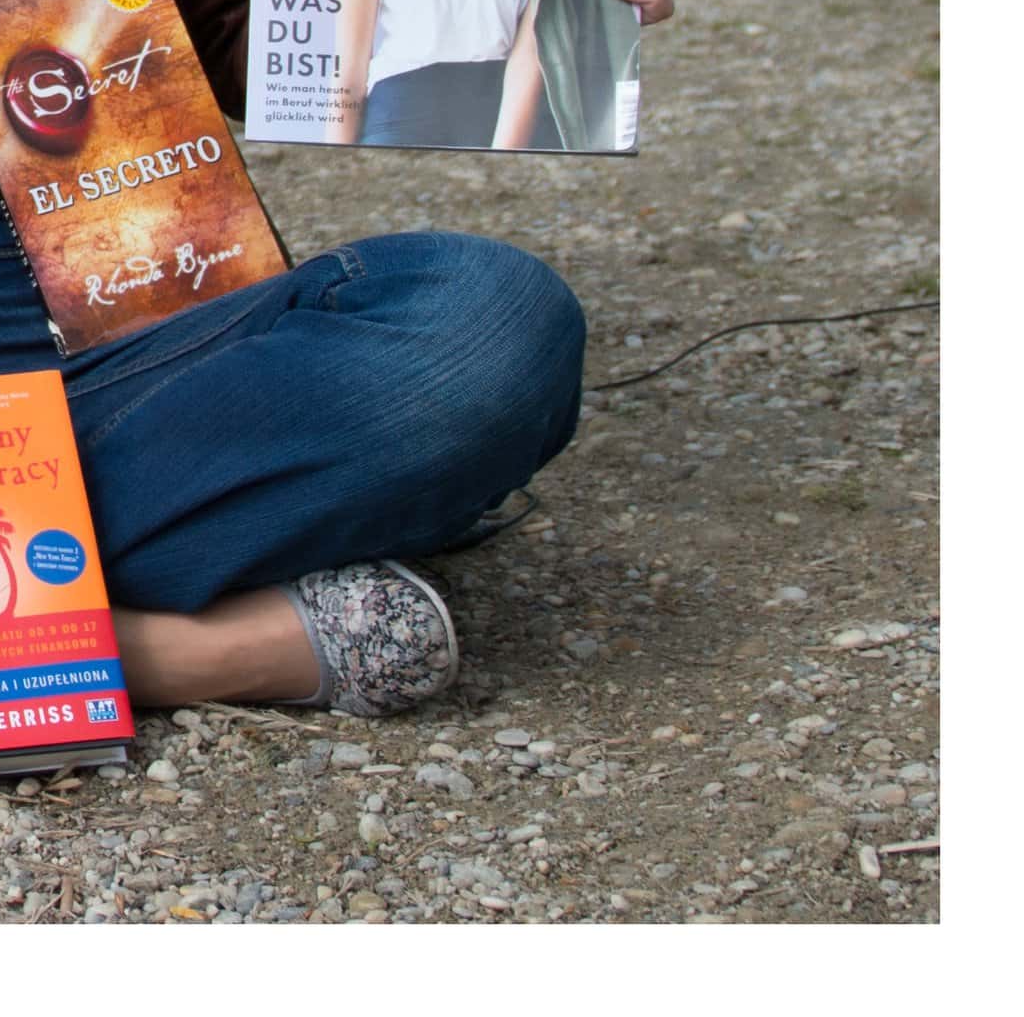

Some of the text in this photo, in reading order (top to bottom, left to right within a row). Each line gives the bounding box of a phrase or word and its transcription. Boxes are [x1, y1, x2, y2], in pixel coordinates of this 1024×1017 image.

[268, 20, 312, 44] DU
[266, 52, 340, 78] BIST!
[29, 39, 172, 117] Secret
[266, 83, 351, 95] Wie man heute
[265, 97, 361, 110] im Beruf wirklich
[265, 111, 345, 124] glücklich wird
[29, 135, 222, 215] EL SECRETO
[85, 242, 243, 306] Rhonda Byrne
[83, 621, 97, 633] 17
[29, 637, 97, 656] FINANSOWO
[13, 680, 18, 690] I
[22, 669, 109, 690] UZUPEŁNIONA
